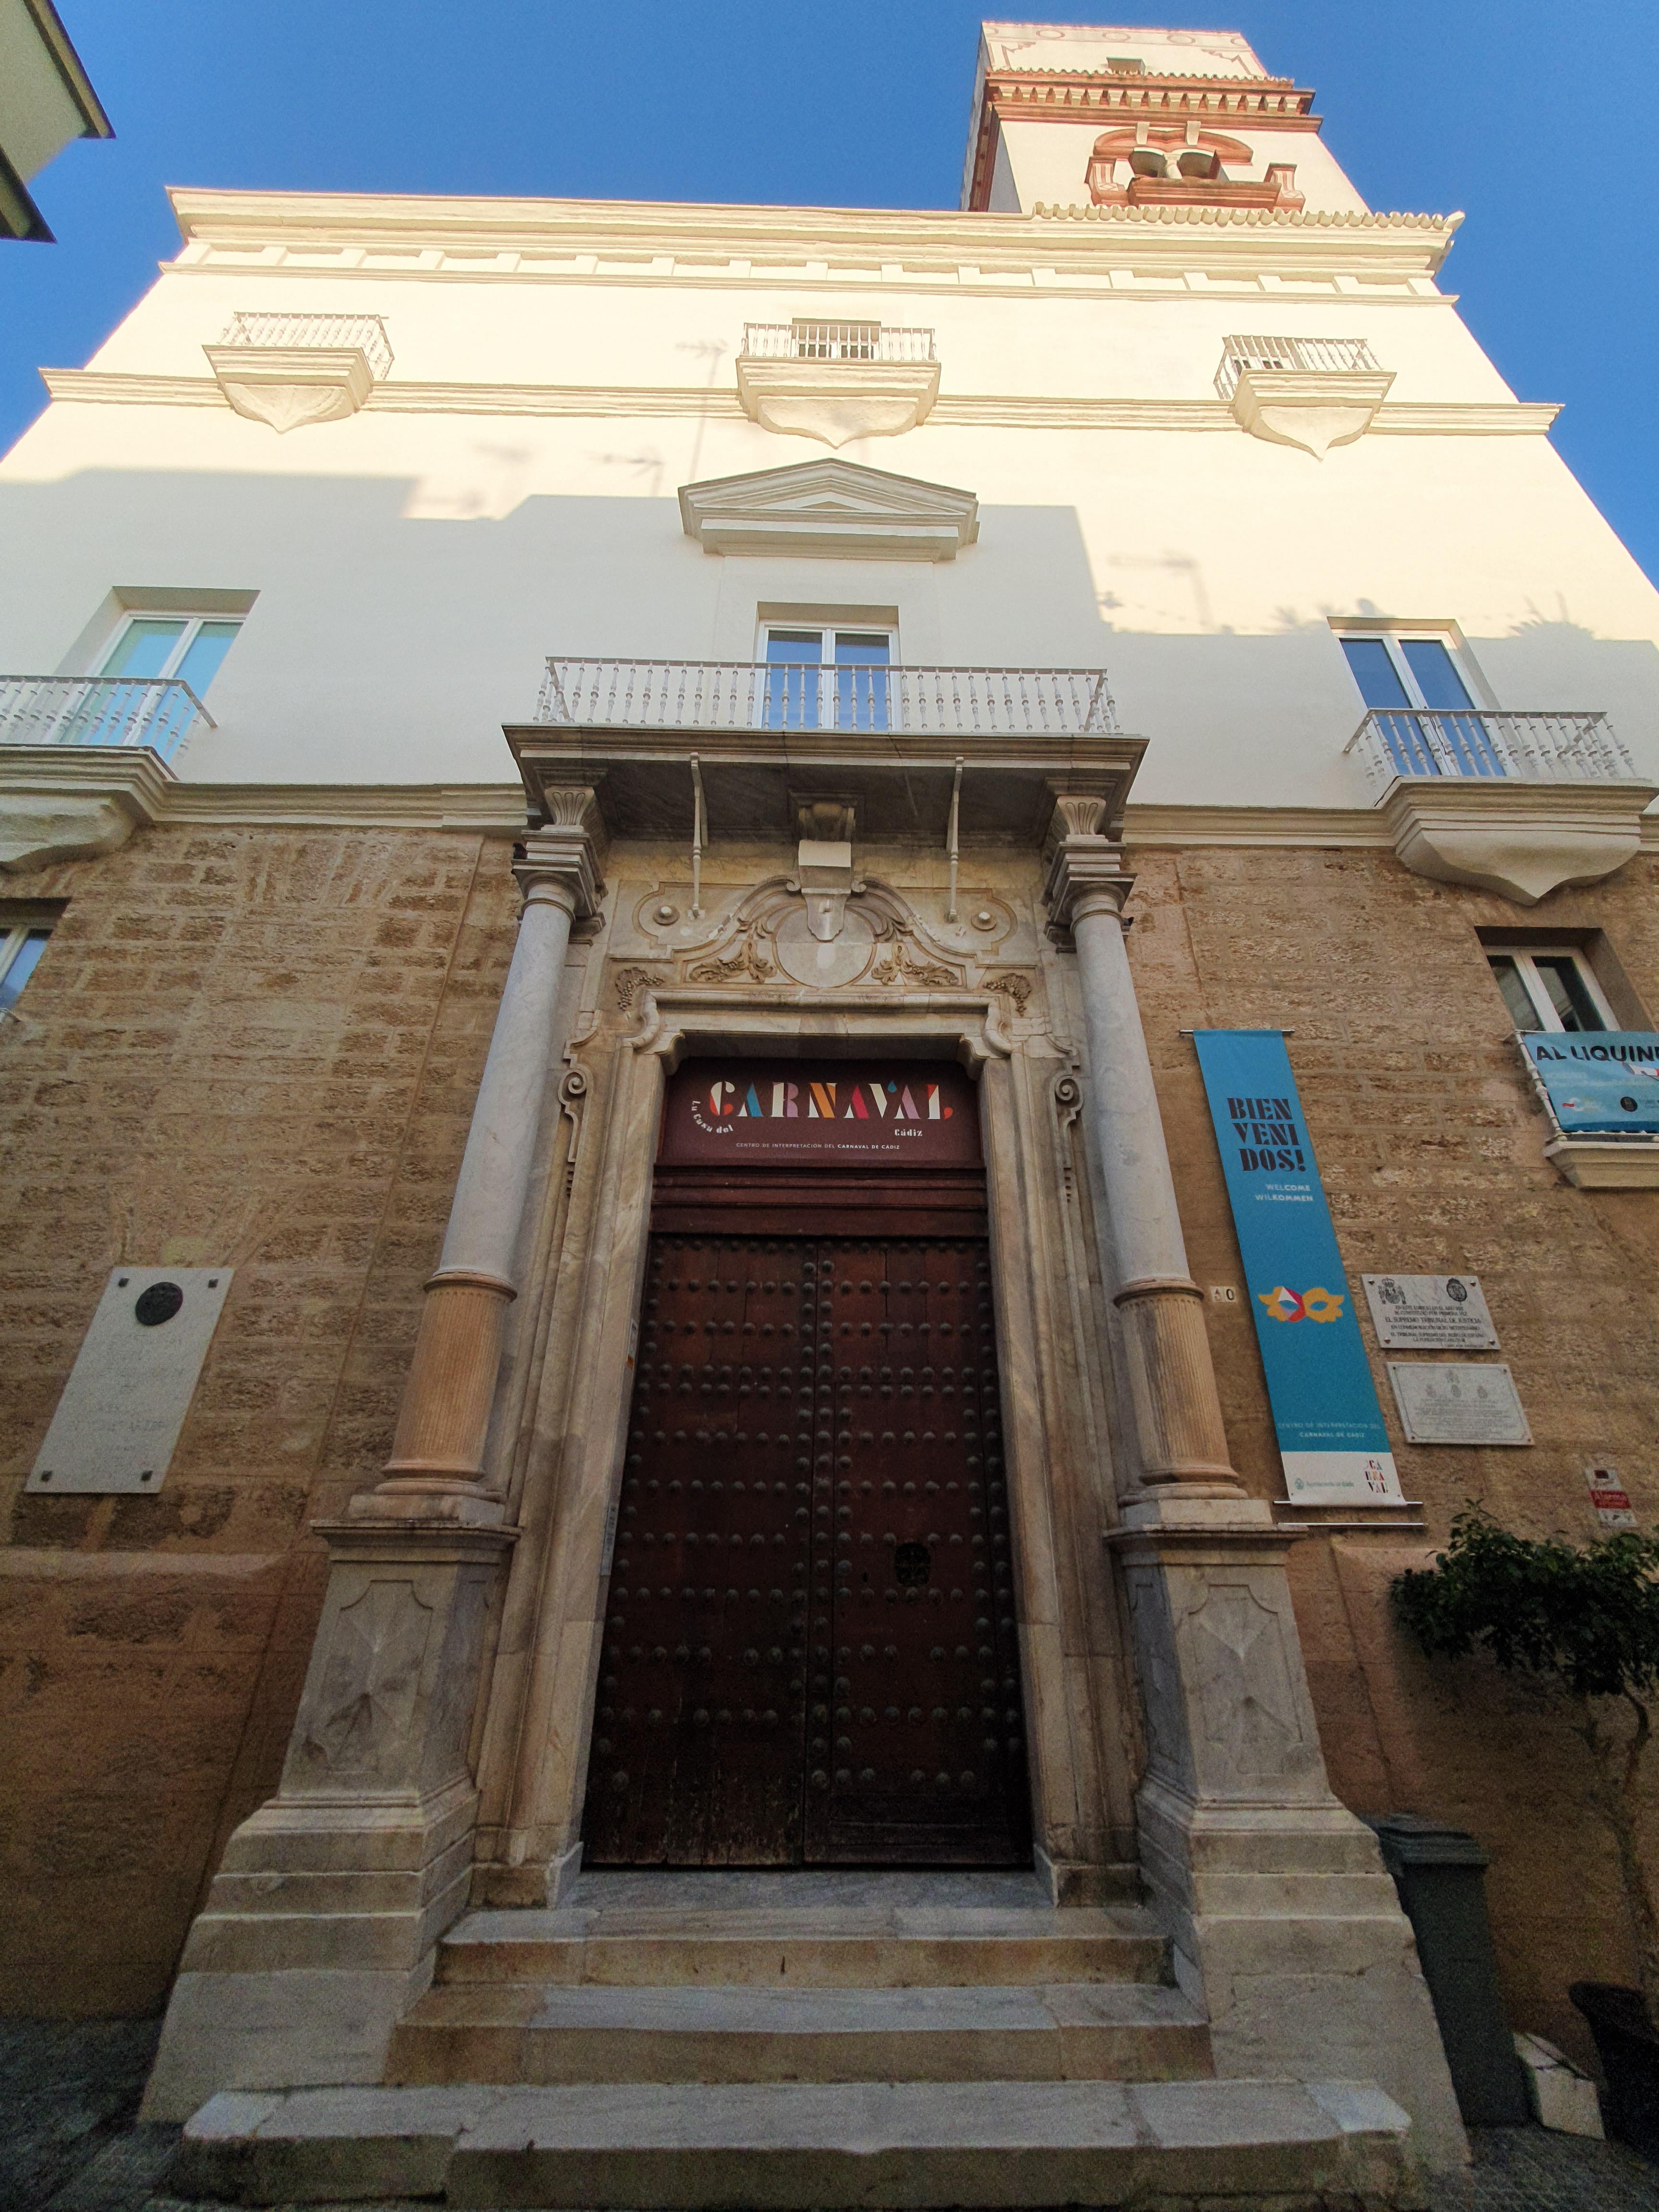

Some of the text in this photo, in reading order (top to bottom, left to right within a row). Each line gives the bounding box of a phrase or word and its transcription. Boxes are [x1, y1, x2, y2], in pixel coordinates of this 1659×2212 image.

[1537, 1046, 1567, 1060] AL
[709, 1081, 953, 1119] CARNAVAL
[1226, 1098, 1293, 1120] BIEN
[693, 1114, 713, 1132] Casa
[716, 1124, 733, 1133] del
[1232, 1122, 1300, 1146] VENI
[1238, 1148, 1306, 1172] DOS!
